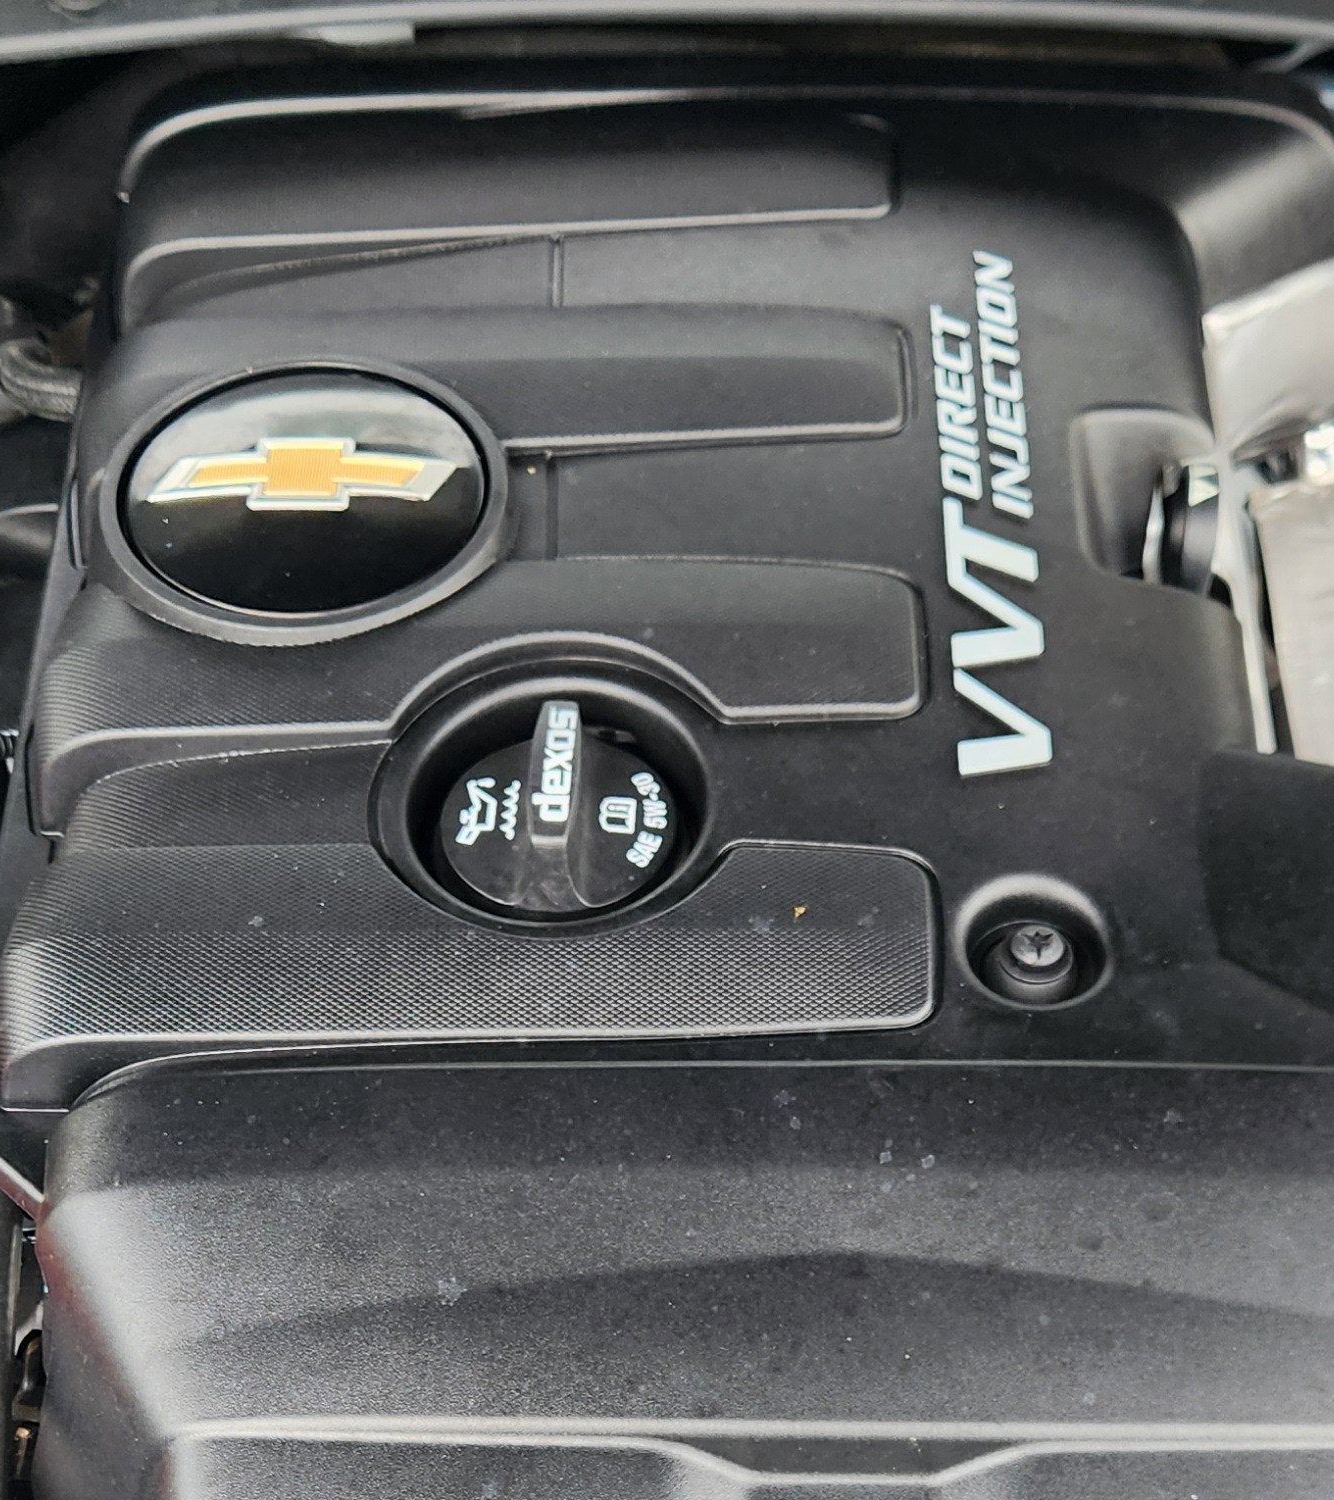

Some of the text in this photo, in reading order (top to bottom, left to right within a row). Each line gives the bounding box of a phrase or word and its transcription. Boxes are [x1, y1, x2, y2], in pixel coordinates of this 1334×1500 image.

[930, 304, 982, 501] DIRECT
[973, 250, 1034, 519] INJECTION
[942, 496, 1053, 778] VVT
[532, 707, 578, 822] dexos
[626, 771, 668, 868] SAE 5W-30
